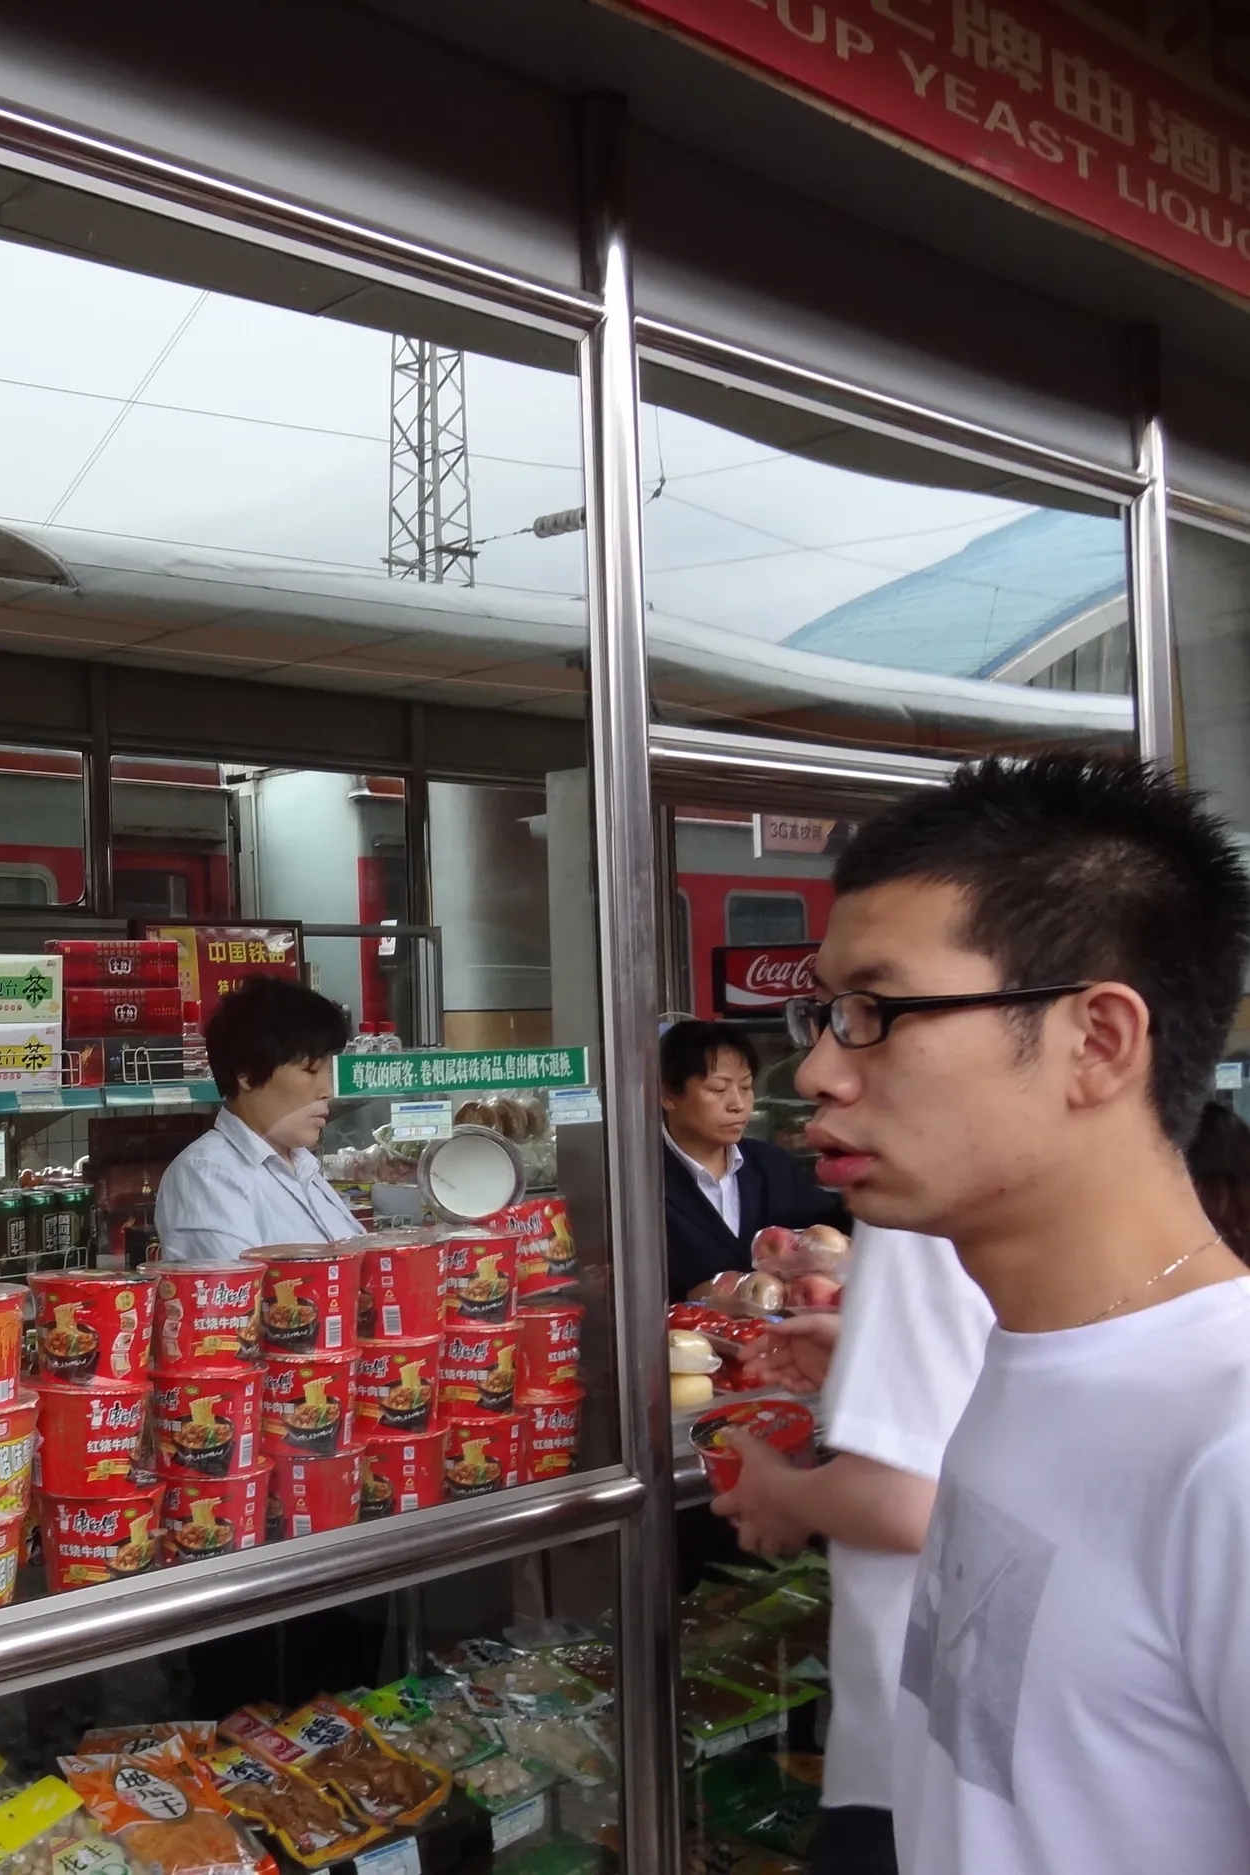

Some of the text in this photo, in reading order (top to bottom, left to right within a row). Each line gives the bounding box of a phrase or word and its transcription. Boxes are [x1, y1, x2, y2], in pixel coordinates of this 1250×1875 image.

[899, 47, 1099, 180] YEAST
[746, 953, 820, 990] Coca-Co
[211, 1281, 253, 1309] 康师傅
[194, 1316, 249, 1332] 红烧牛肉面
[451, 1339, 489, 1363] 康师傅
[107, 1402, 141, 1430] 康师傅
[87, 1435, 138, 1453] 红烧牛肉面
[73, 1508, 121, 1538] 康师傅
[59, 1544, 119, 1559] 红烧牛肉面
